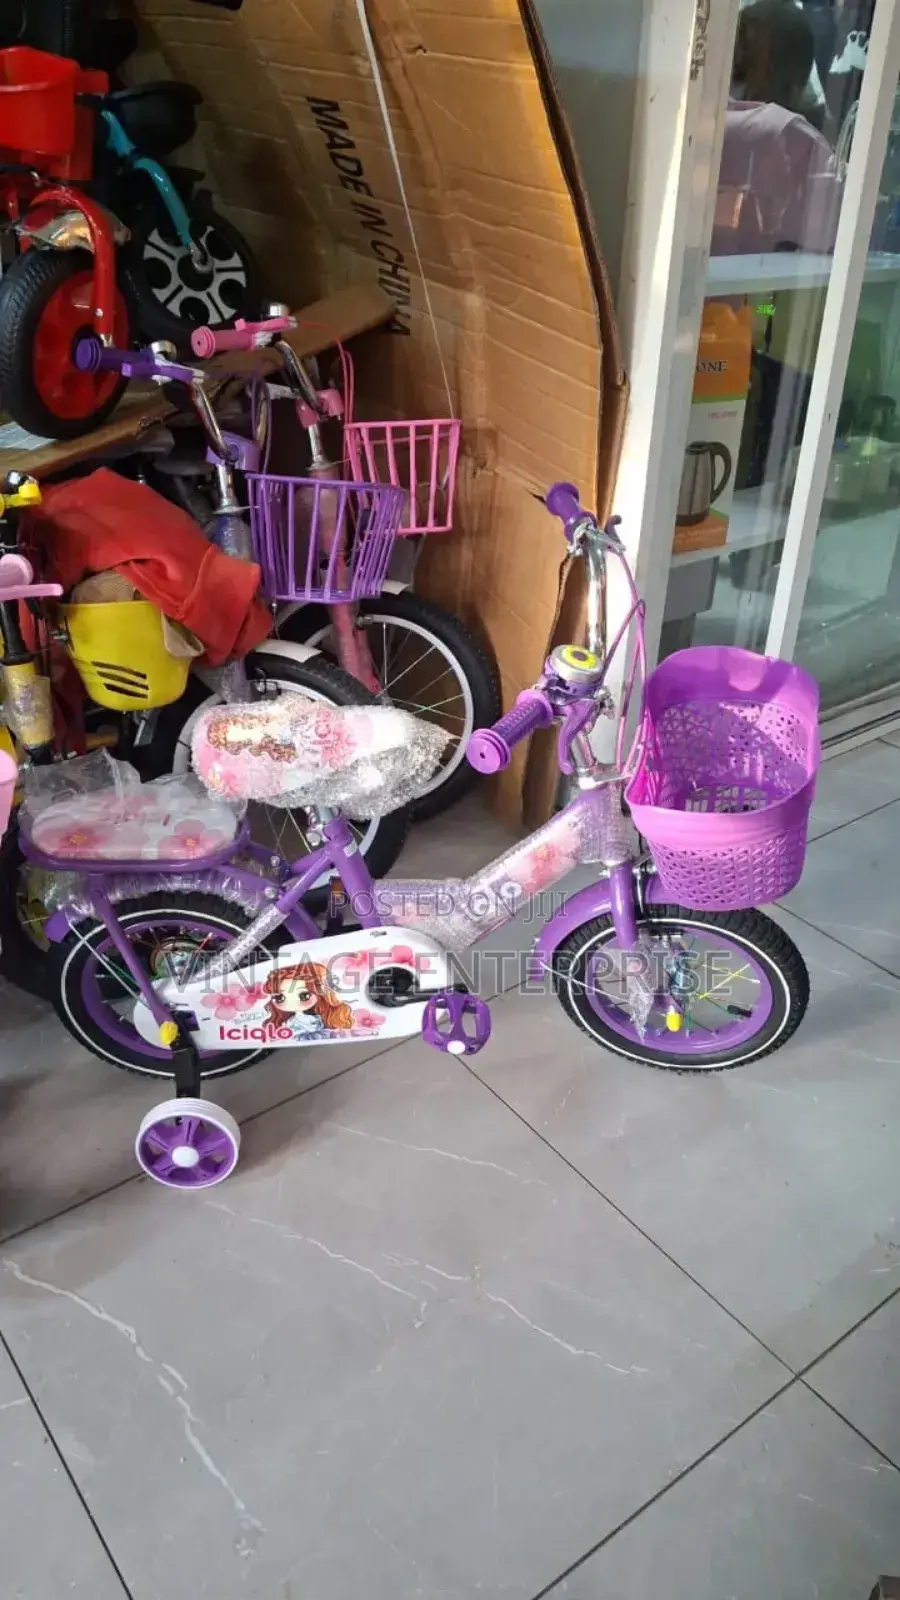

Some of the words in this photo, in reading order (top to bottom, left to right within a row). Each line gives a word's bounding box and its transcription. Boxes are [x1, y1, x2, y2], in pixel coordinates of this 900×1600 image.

[305, 96, 374, 198] MADE
[351, 201, 393, 238] IN
[371, 240, 411, 336] CHINA
